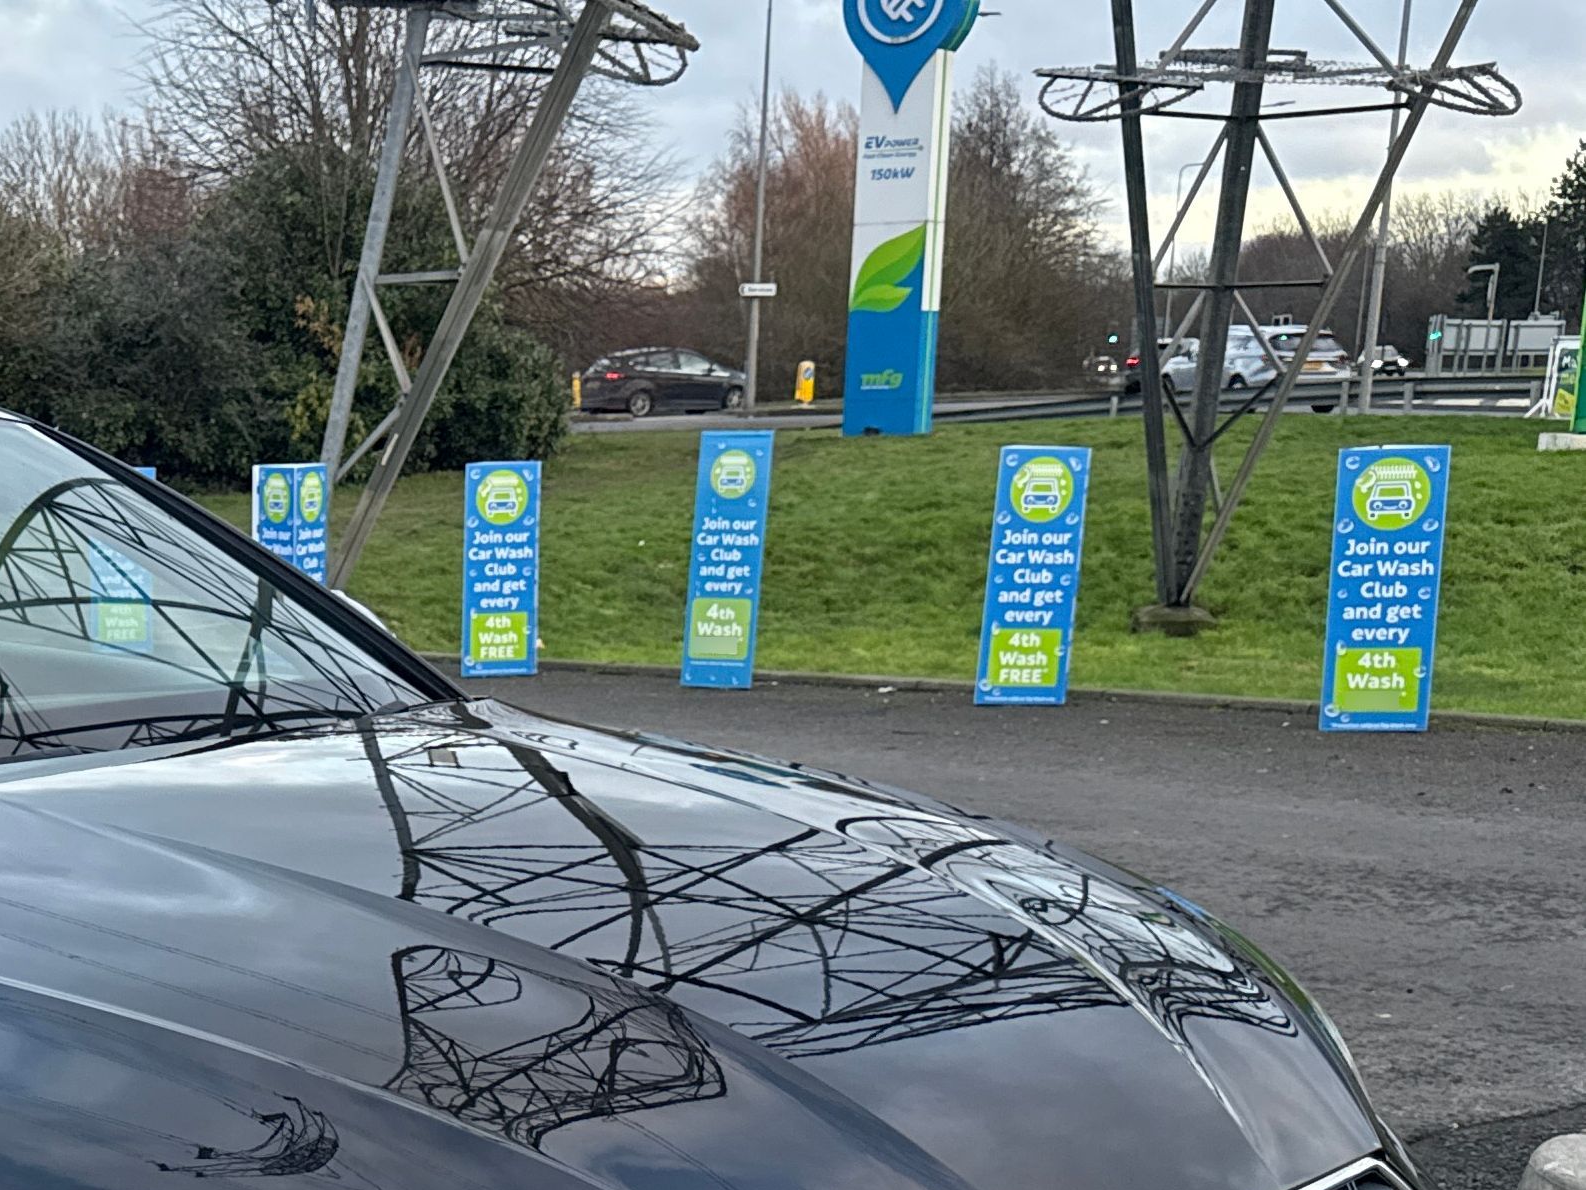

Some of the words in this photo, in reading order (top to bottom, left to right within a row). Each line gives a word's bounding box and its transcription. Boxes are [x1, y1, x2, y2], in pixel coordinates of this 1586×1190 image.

[865, 135, 886, 149] EV
[870, 167, 915, 181] 150kW
[702, 516, 730, 530] Join
[732, 519, 757, 531] our
[473, 530, 502, 545] Join
[504, 531, 531, 543] our
[696, 532, 720, 546] Car
[721, 533, 759, 546] Wash
[1002, 528, 1039, 545] Join
[1041, 531, 1072, 545] our
[468, 547, 493, 560] Car
[494, 546, 533, 559] Wash
[1344, 537, 1389, 556] Join
[1393, 540, 1431, 555] our
[710, 548, 742, 562] Club
[995, 549, 1025, 565] Car
[1027, 549, 1075, 565] Wash
[484, 562, 517, 576] Club
[699, 564, 725, 577] and
[726, 565, 751, 580] get
[1013, 568, 1053, 584] Club
[1337, 560, 1373, 577] Car
[1376, 559, 1434, 577] Wash
[474, 579, 500, 592] and
[502, 579, 527, 595] get
[704, 581, 742, 595] every
[1360, 581, 1408, 598] Club
[479, 597, 520, 609] every
[998, 588, 1031, 603] and
[1033, 589, 1064, 607] get
[706, 603, 735, 620] 4th
[1004, 610, 1053, 626] every
[1342, 603, 1382, 620] and
[1385, 603, 1423, 623] get
[485, 616, 511, 628] 4th
[697, 621, 743, 637] Wash
[478, 631, 518, 644] Wash
[1008, 632, 1041, 647] 4th
[1351, 627, 1410, 644] every
[999, 651, 1048, 666] Wash
[1357, 652, 1396, 669] 4th
[1346, 673, 1405, 690] Wash
